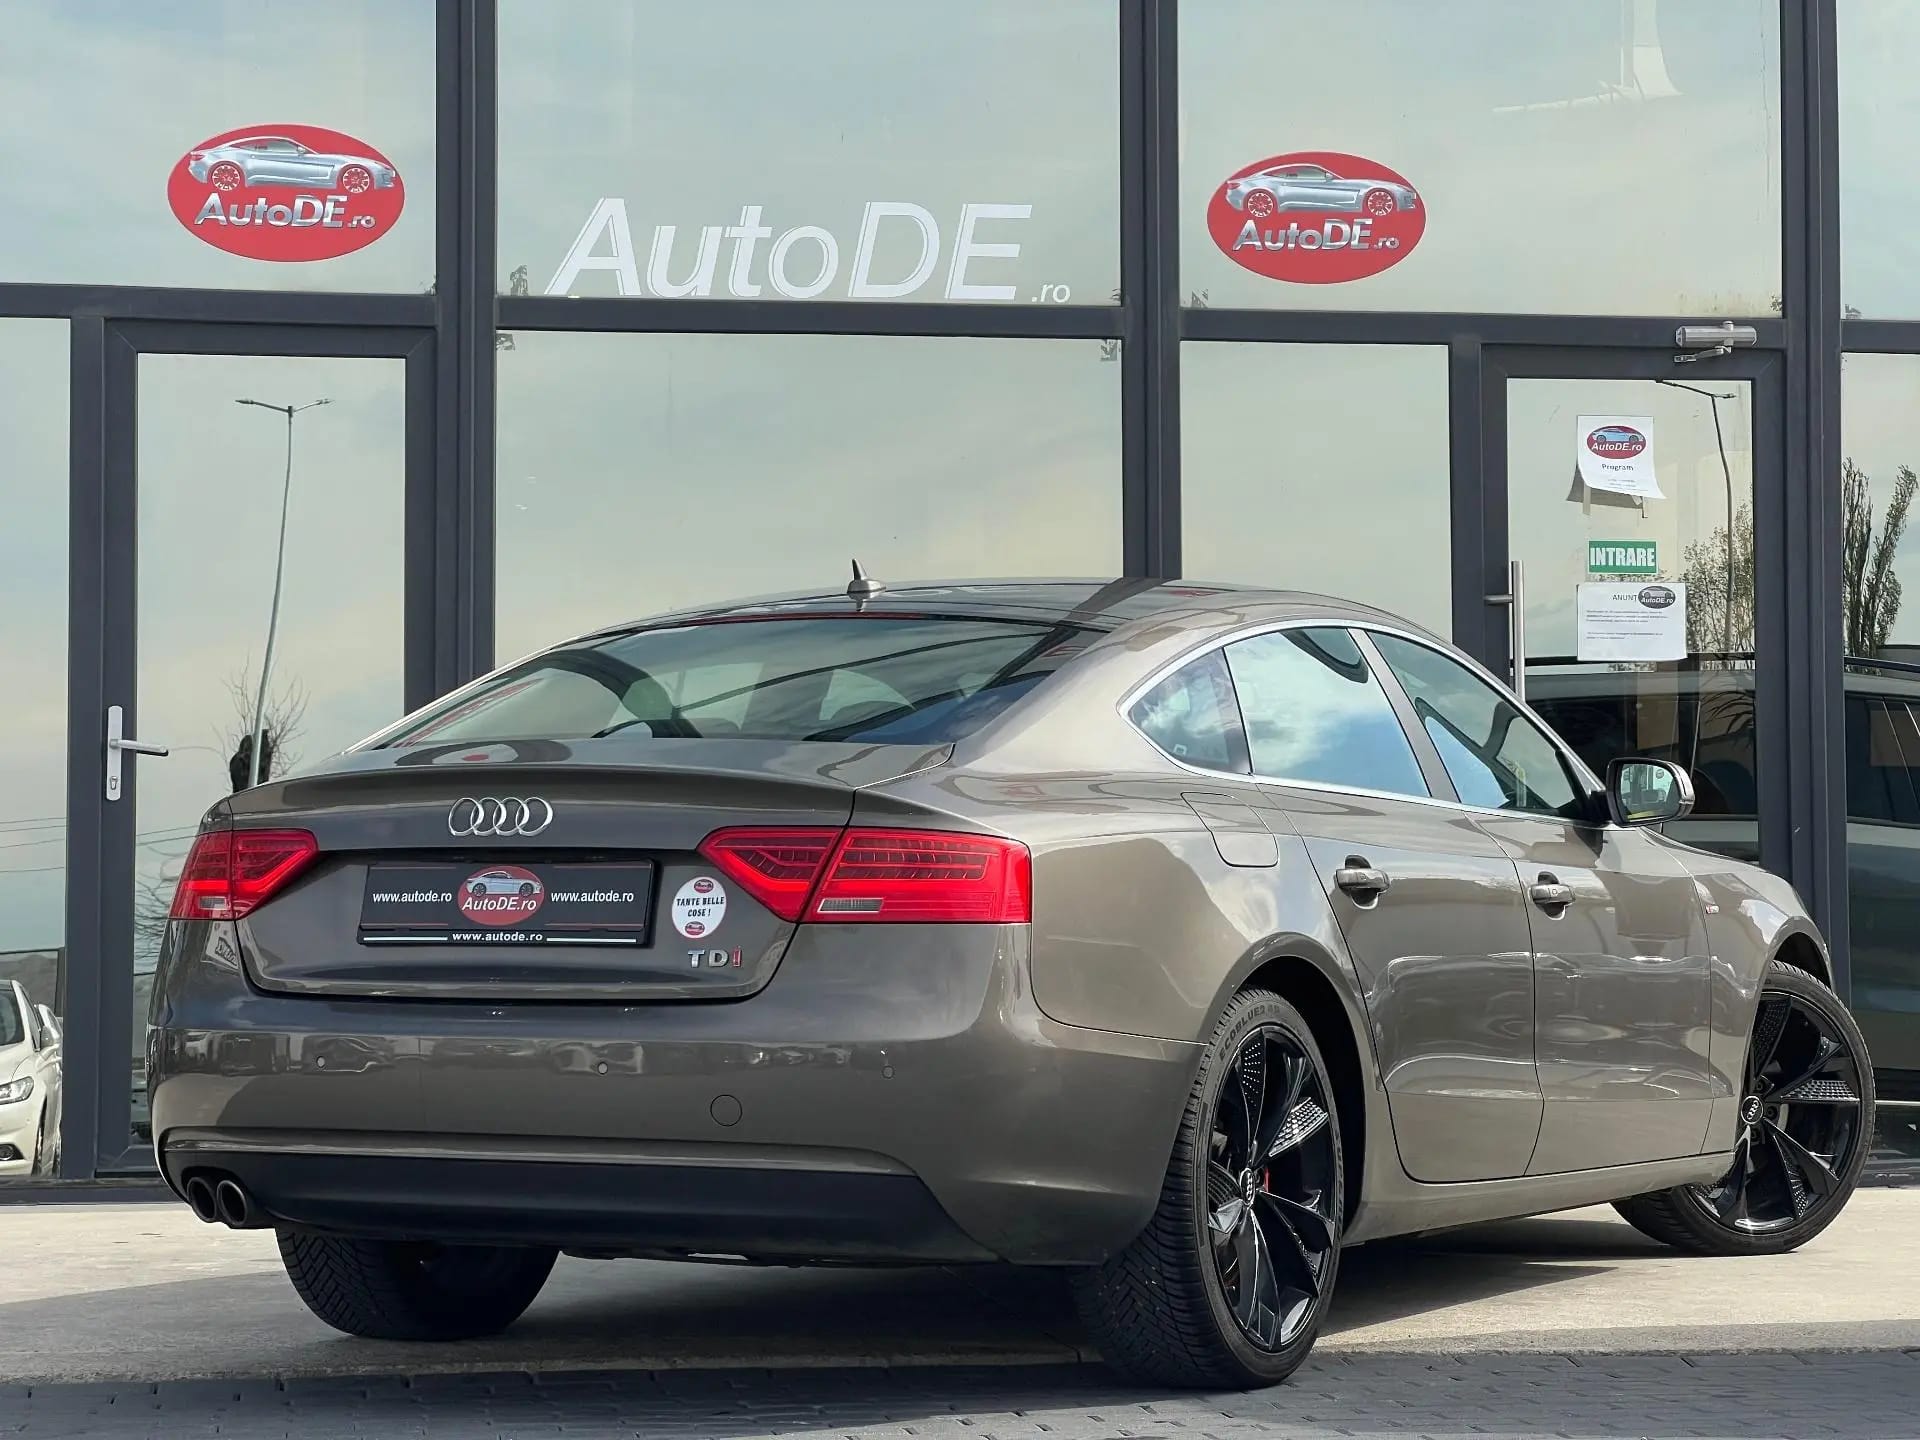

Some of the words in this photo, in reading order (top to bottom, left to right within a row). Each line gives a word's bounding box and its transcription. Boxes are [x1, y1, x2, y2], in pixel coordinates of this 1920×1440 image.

[1591, 442, 1642, 451] AutoDE.ro
[1601, 463, 1634, 471] Program
[1590, 547, 1655, 567] INTRARE
[372, 890, 452, 903] www.autode.ro
[551, 889, 634, 903] www.autode.ro
[676, 897, 700, 907] TANTE
[702, 896, 725, 905] BELLE
[461, 896, 537, 912] AutoDE.ro
[687, 908, 706, 917] COSE
[452, 931, 543, 943] www.autode.ro
